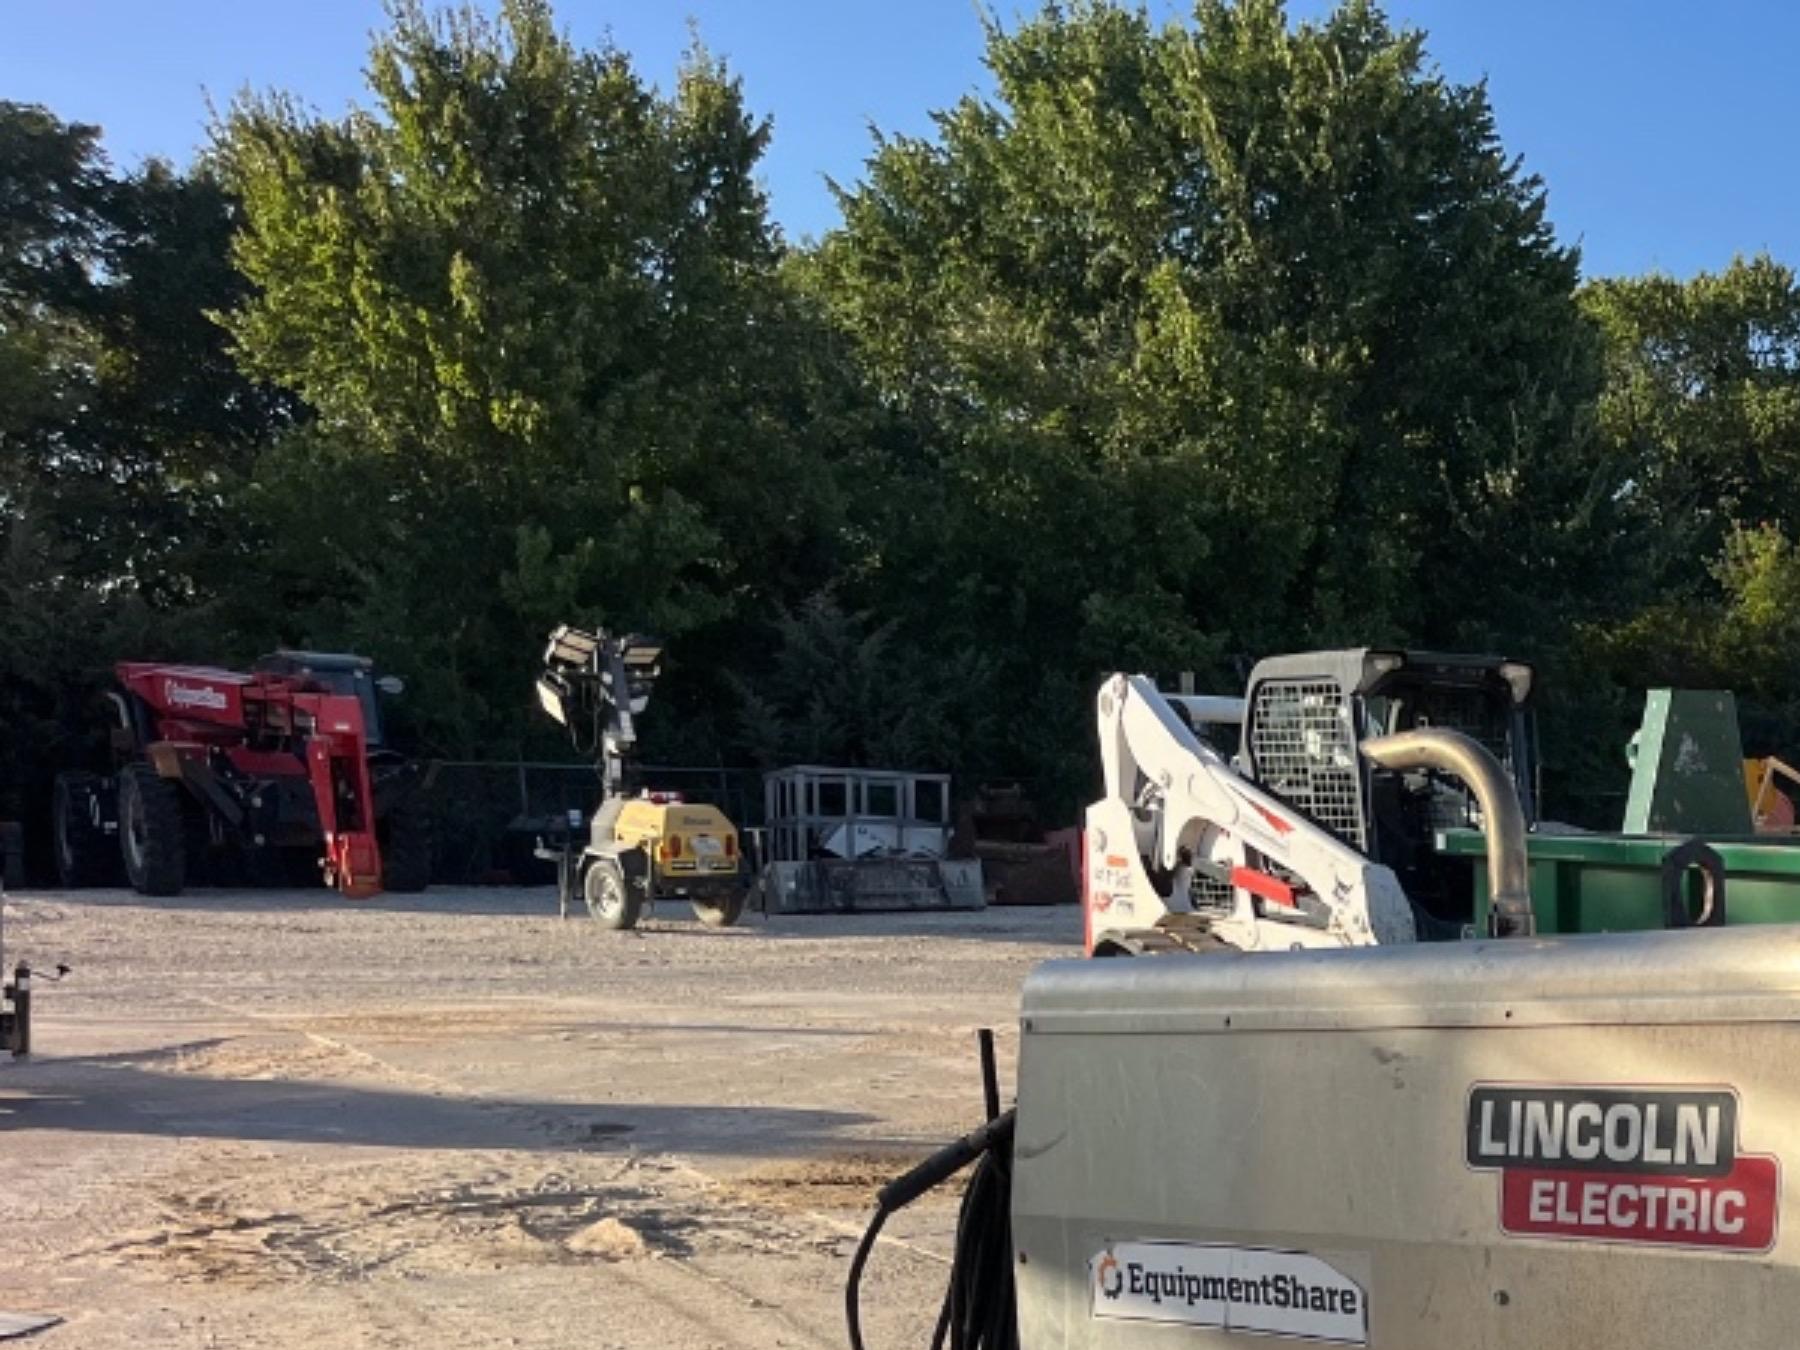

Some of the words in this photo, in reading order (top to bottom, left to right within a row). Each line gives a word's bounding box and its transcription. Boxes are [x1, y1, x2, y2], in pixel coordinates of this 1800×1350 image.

[1478, 1100, 1721, 1165] LINCOLN
[1528, 1180, 1746, 1234] ELECTRIC
[1127, 1263, 1358, 1314] EquipmentShare
